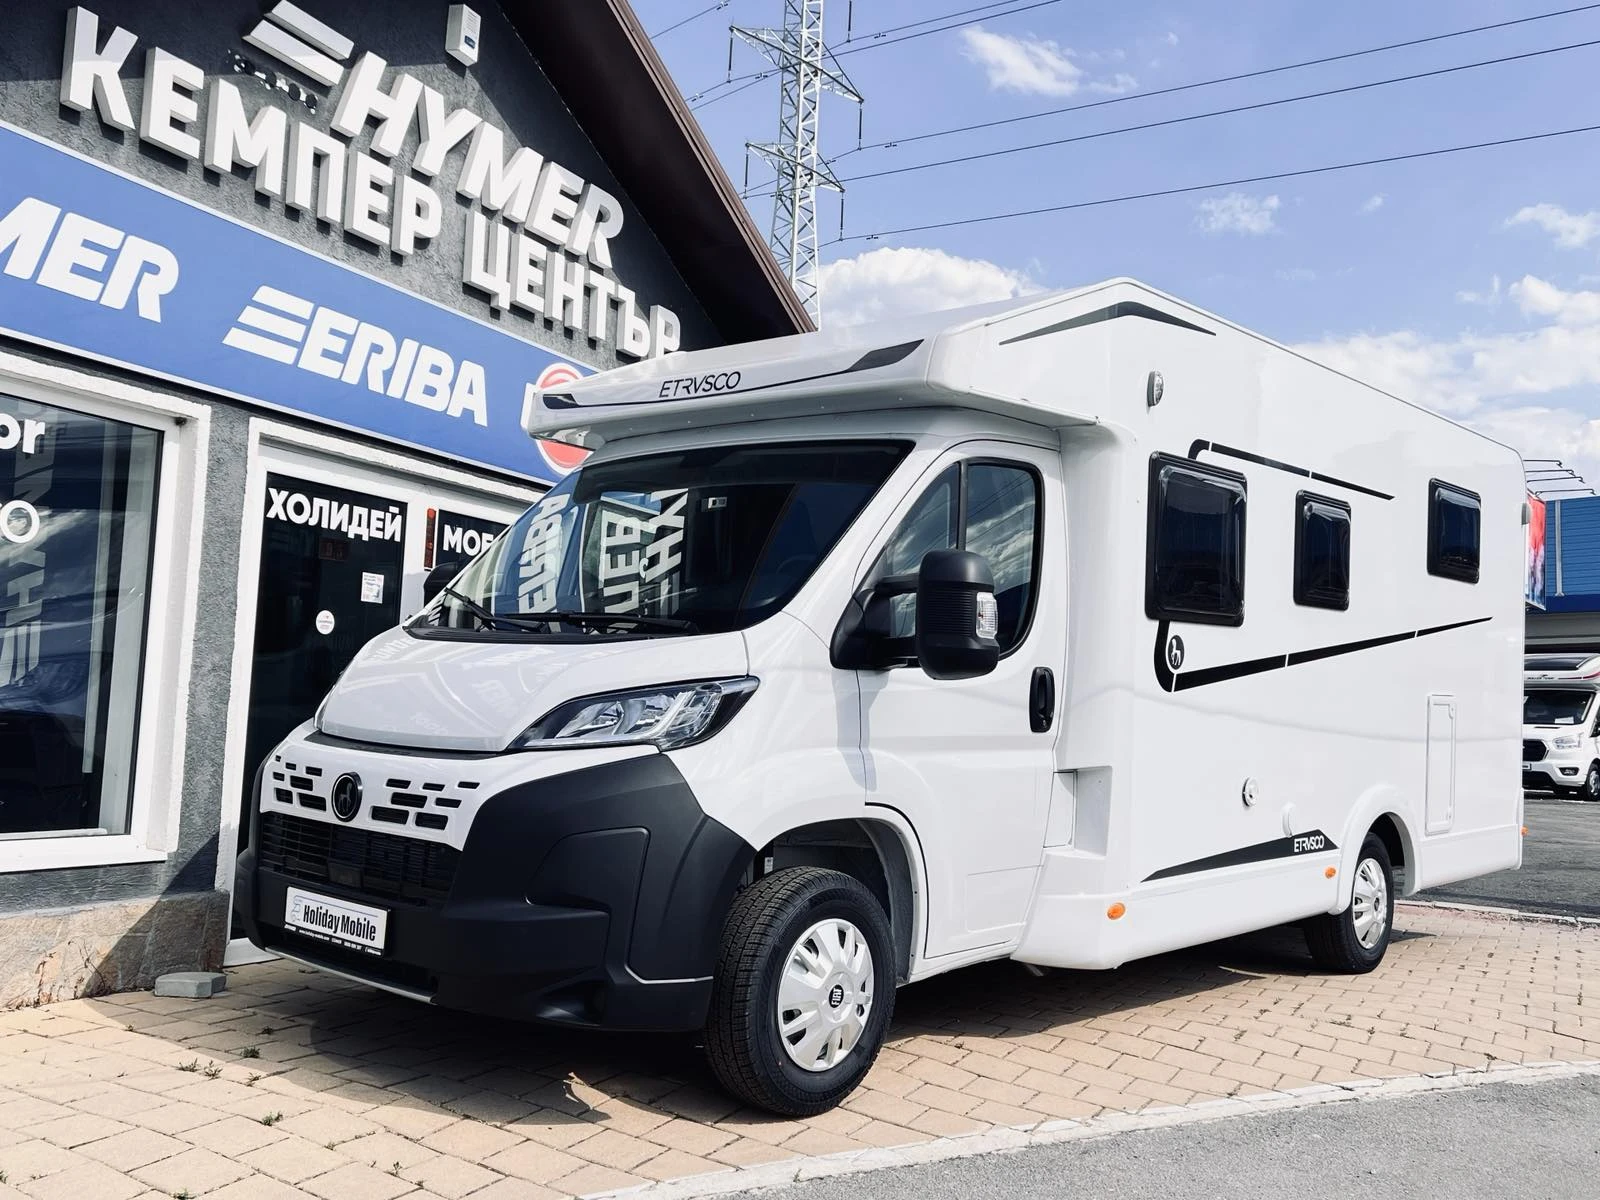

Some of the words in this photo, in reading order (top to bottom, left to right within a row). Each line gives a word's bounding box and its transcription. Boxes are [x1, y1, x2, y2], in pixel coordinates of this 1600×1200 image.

[59, 6, 443, 256] КЕМПЕР
[462, 212, 681, 361] ЦЕНТЪР
[330, 51, 625, 271] HYMER
[297, 306, 488, 427] ERIBA
[266, 487, 402, 542] ХОЛИДЕЙ
[303, 904, 341, 934] Holiday
[340, 914, 377, 942] Mobile
[832, 988, 842, 1006] FIAT
